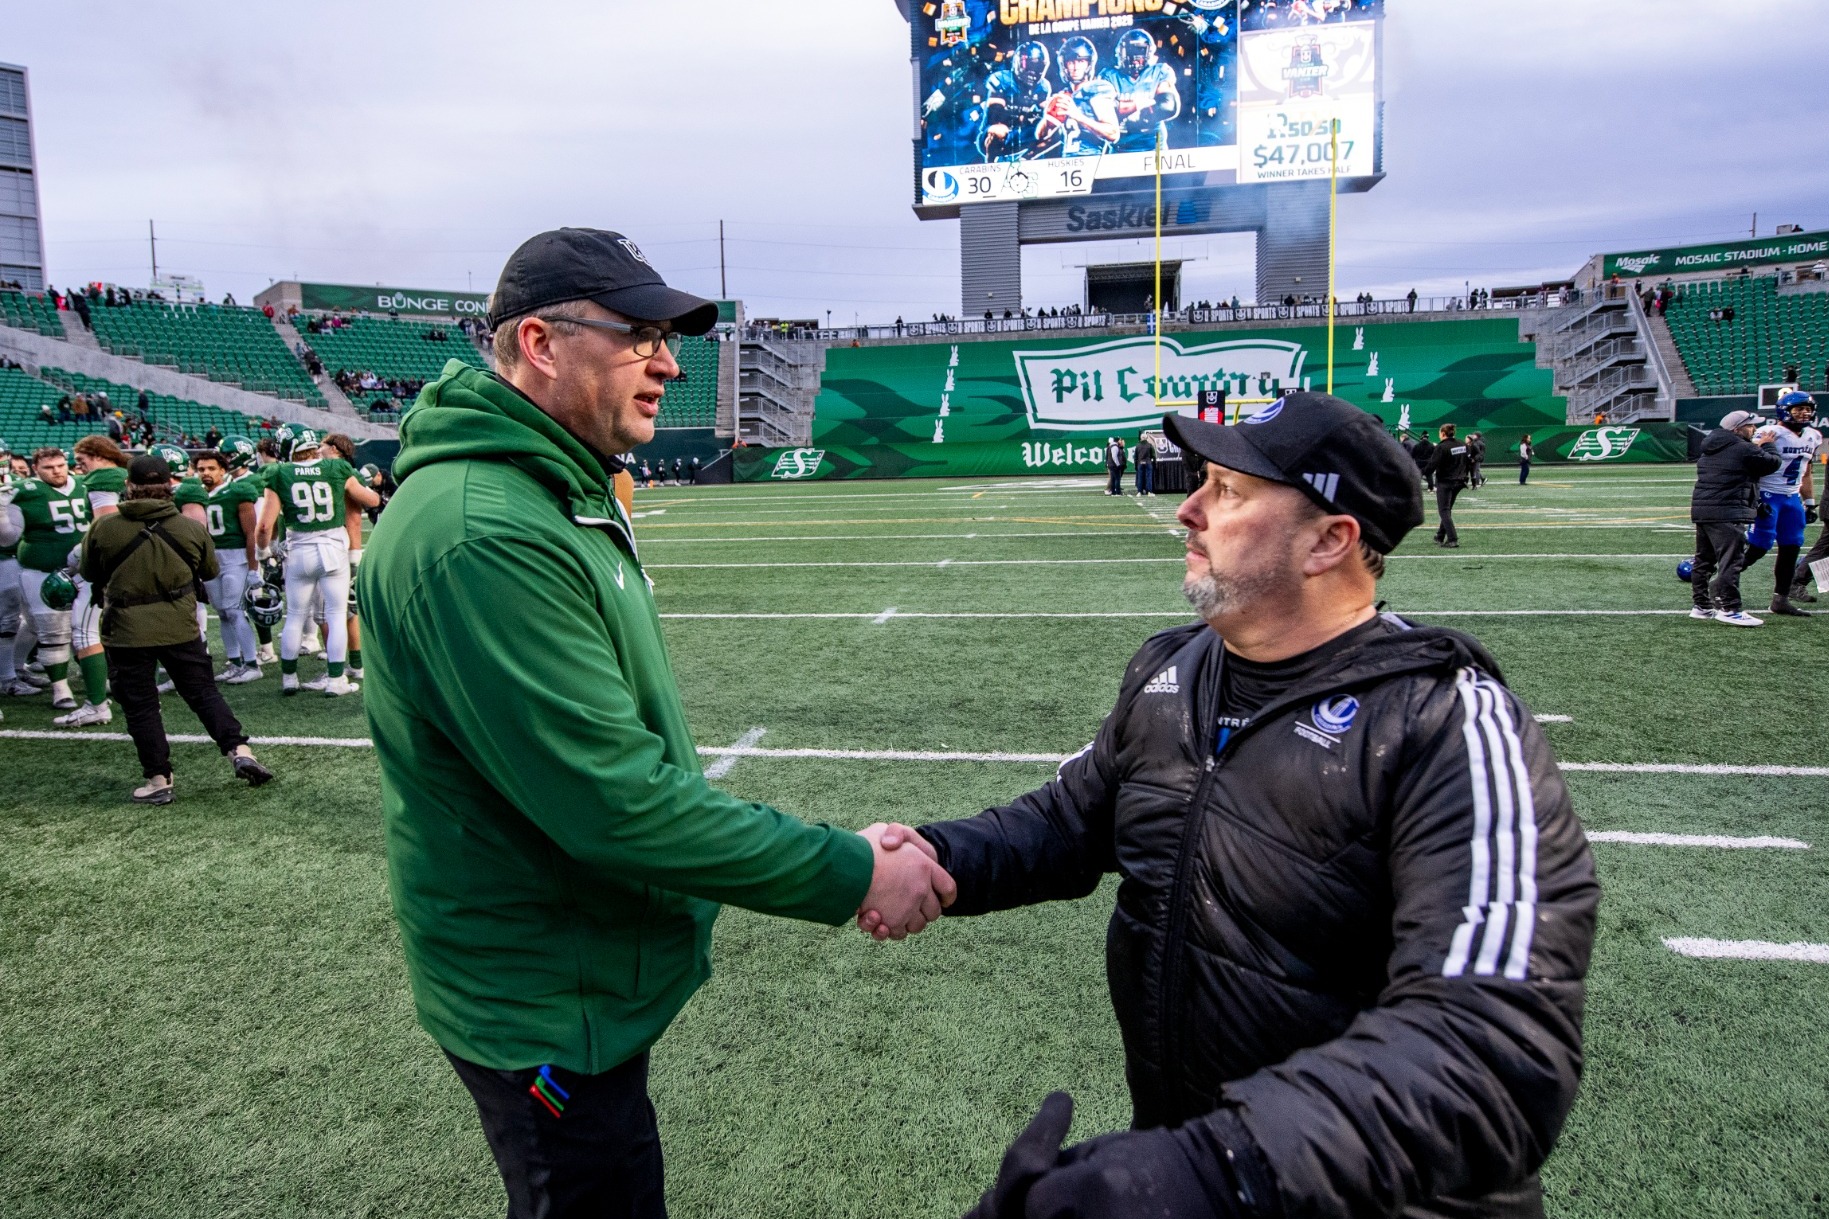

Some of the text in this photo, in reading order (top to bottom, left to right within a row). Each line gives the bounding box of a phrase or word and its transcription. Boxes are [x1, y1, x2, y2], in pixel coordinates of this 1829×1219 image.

[1000, 0, 1163, 25] CHAMPI
[1029, 24, 1041, 35] DE
[1041, 23, 1051, 34] LA
[1052, 20, 1079, 33] COUPE
[1080, 17, 1110, 30] VANIER
[1254, 141, 1354, 168] $47,007
[1047, 158, 1085, 168] HUSKIES
[1144, 153, 1196, 171] FNAL
[959, 164, 1001, 175] CARABINS
[1258, 169, 1294, 179] WINNER
[1297, 167, 1325, 176] TAKES
[1060, 169, 1082, 187] 16
[968, 176, 991, 194] 30
[1067, 200, 1170, 232] SaskTel
[1675, 252, 1721, 266] MOSAIC
[1724, 246, 1780, 262] STADIUM
[1788, 240, 1829, 255] HOME
[1615, 253, 1661, 267] Mosaic
[377, 294, 449, 311] BUNGE
[1385, 301, 1410, 313] SPORTS
[1211, 309, 1233, 321] SPORTS
[1254, 307, 1276, 319] SPORTS
[1296, 305, 1320, 318] SPORTS
[1340, 303, 1365, 316] SPORTS
[964, 320, 985, 333] SPORTS
[1003, 319, 1025, 331] SPORTS
[1043, 317, 1065, 329] SPORTS
[1084, 315, 1106, 327] SPORTS
[1050, 367, 1104, 403] Pil
[1021, 441, 1138, 468] Welcoe
[294, 466, 321, 476] PARKS
[1783, 455, 1804, 486] 4
[291, 481, 335, 524] 99
[1144, 682, 1180, 693] adidas
